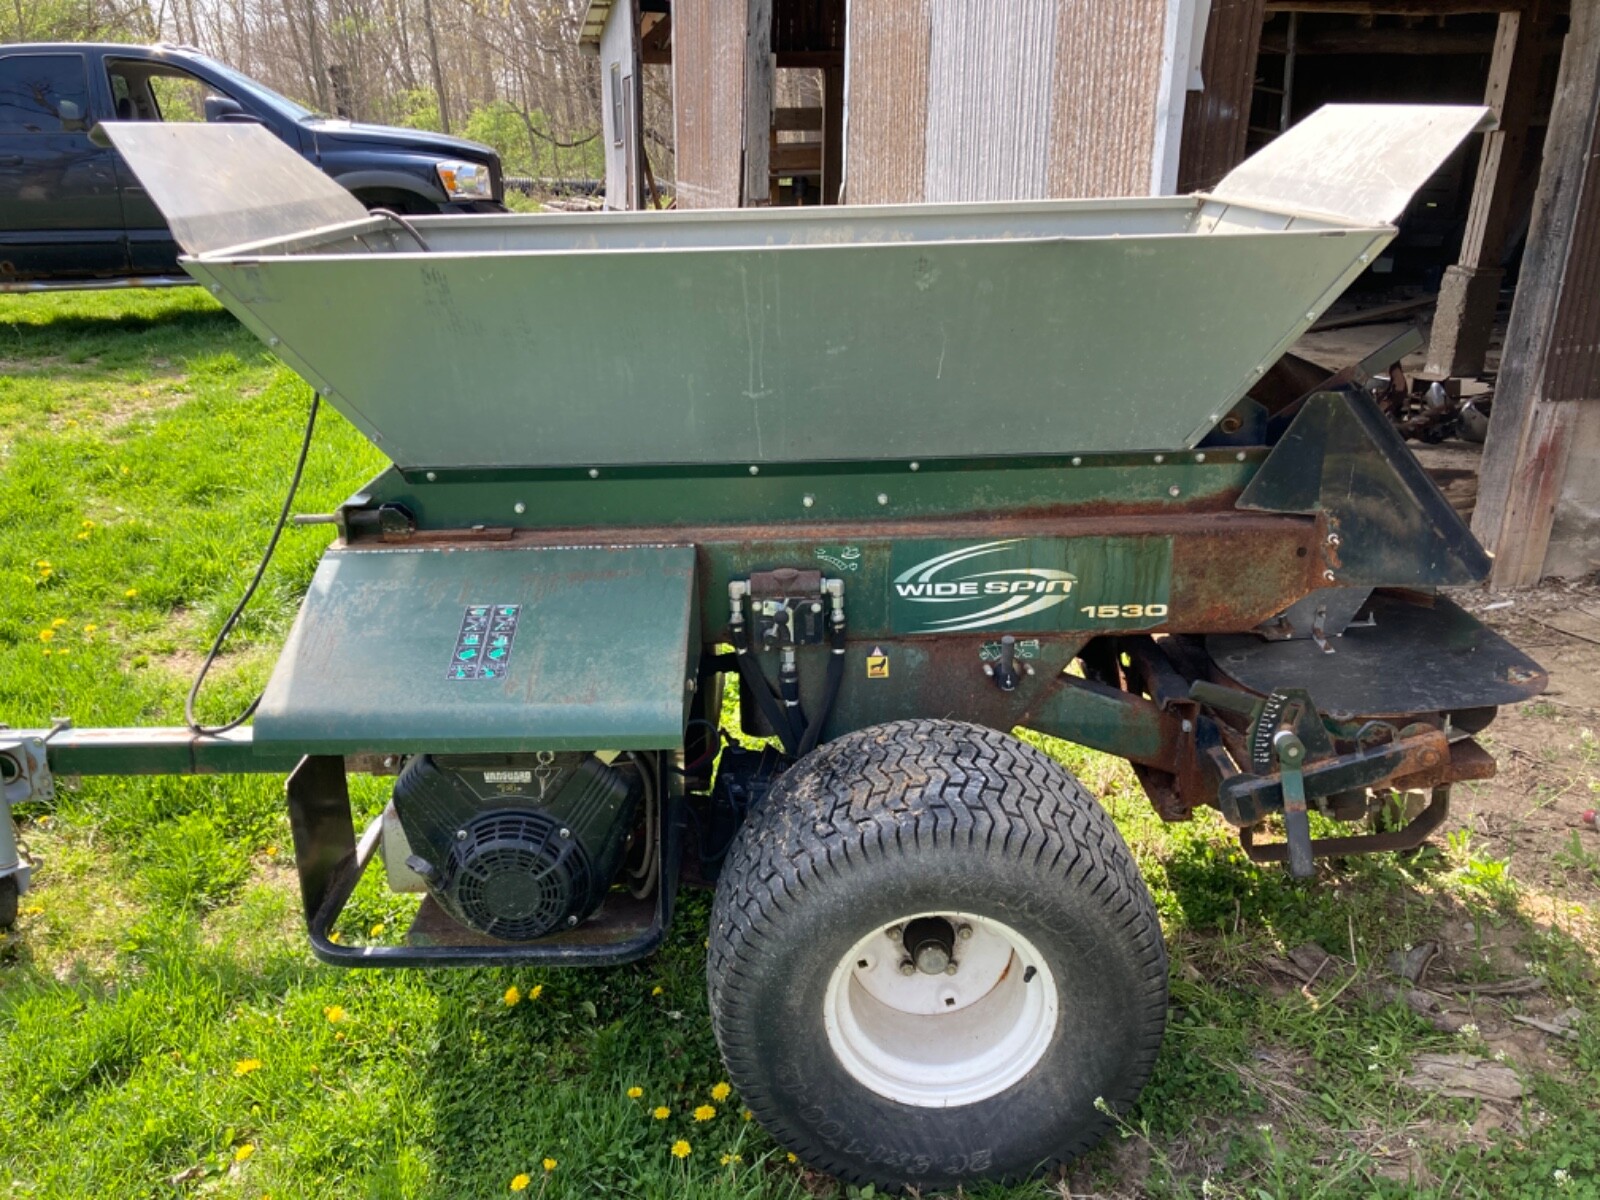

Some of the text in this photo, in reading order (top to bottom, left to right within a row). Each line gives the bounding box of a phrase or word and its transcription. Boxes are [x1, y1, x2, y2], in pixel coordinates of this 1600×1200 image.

[896, 583, 978, 597] WIDE
[1081, 604, 1168, 619] 1530
[484, 771, 532, 783] VANGUARD
